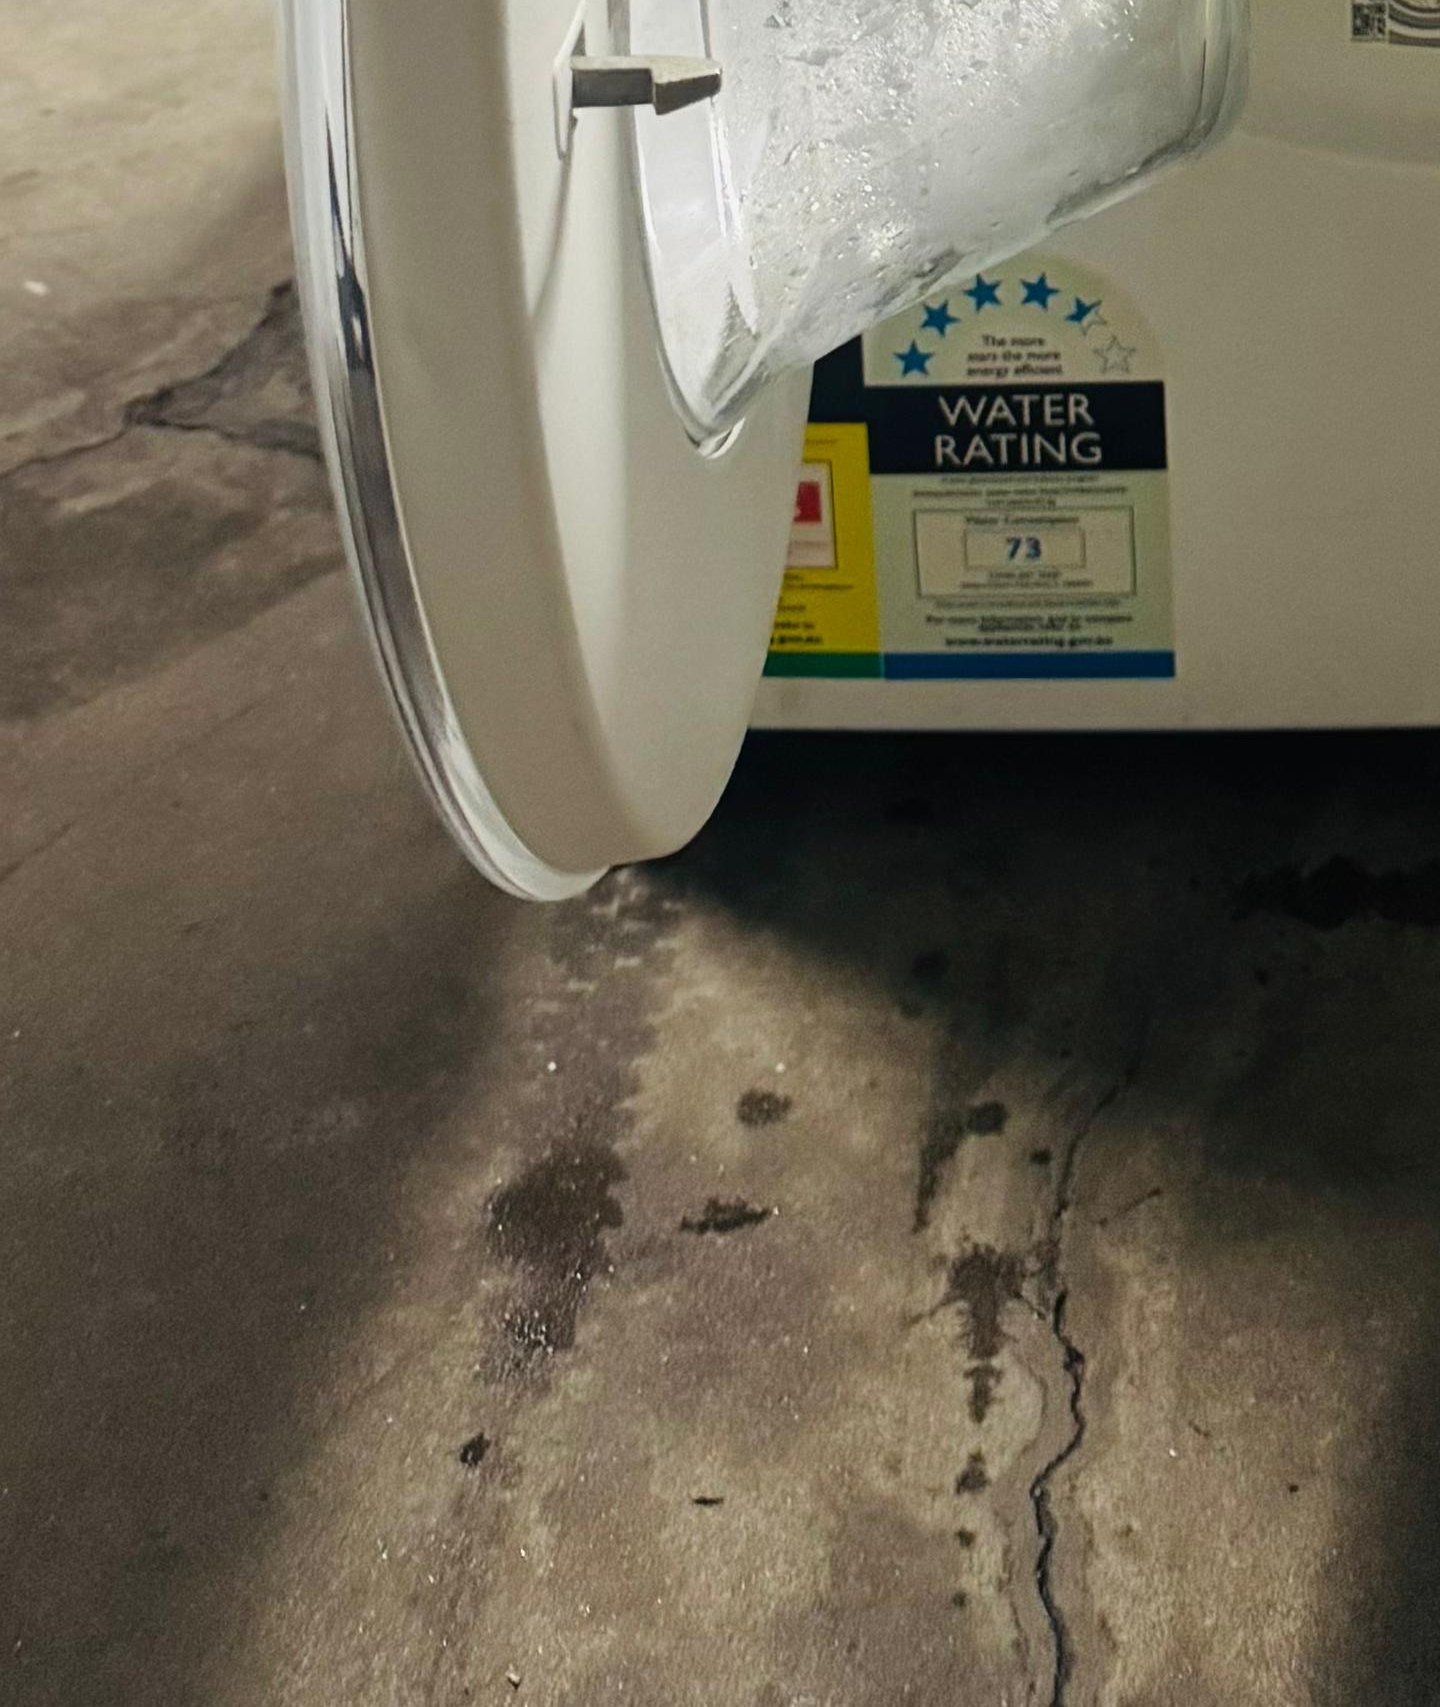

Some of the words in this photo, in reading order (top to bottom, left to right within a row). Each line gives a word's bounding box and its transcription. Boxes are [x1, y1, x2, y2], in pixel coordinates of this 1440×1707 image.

[981, 334, 1007, 347] The
[1010, 337, 1046, 347] more
[1002, 350, 1023, 362] the
[1026, 351, 1061, 362] more
[939, 393, 1096, 428] WATER
[934, 432, 1102, 467] RATING
[1005, 536, 1043, 561] 73
